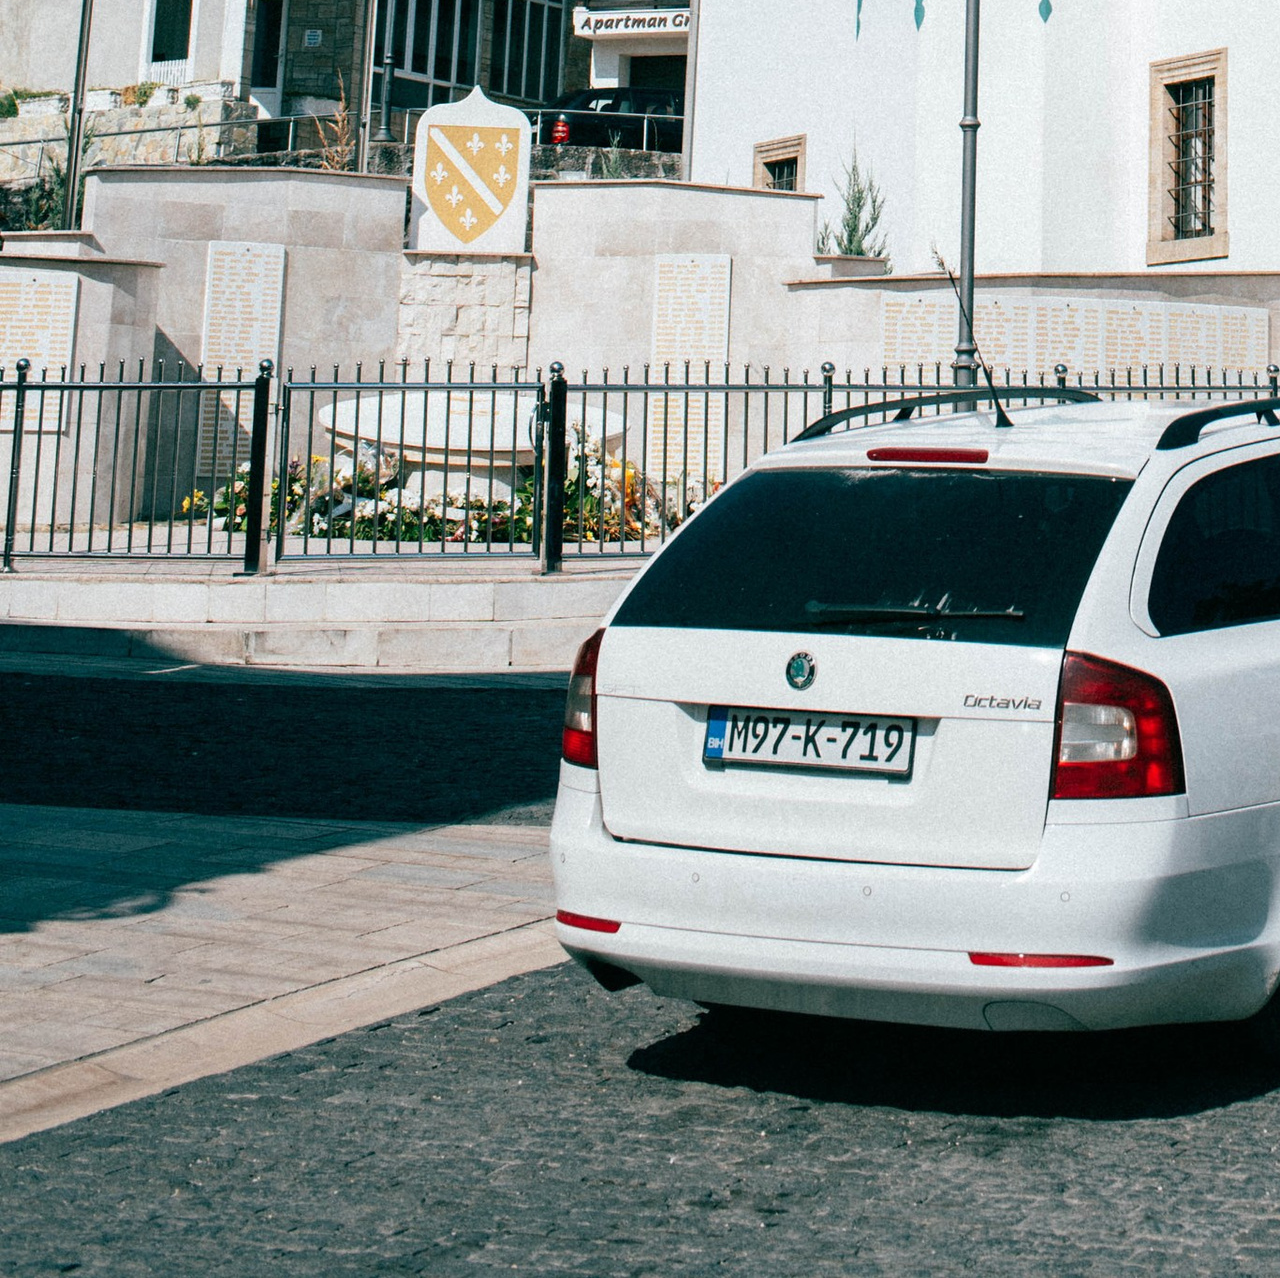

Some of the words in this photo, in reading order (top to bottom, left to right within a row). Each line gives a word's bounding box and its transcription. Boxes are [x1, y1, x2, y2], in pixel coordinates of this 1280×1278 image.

[581, 15, 668, 34] Apartman
[963, 694, 1042, 710] Octavia
[708, 737, 724, 749] BIH
[728, 714, 904, 762] M97-K-719
